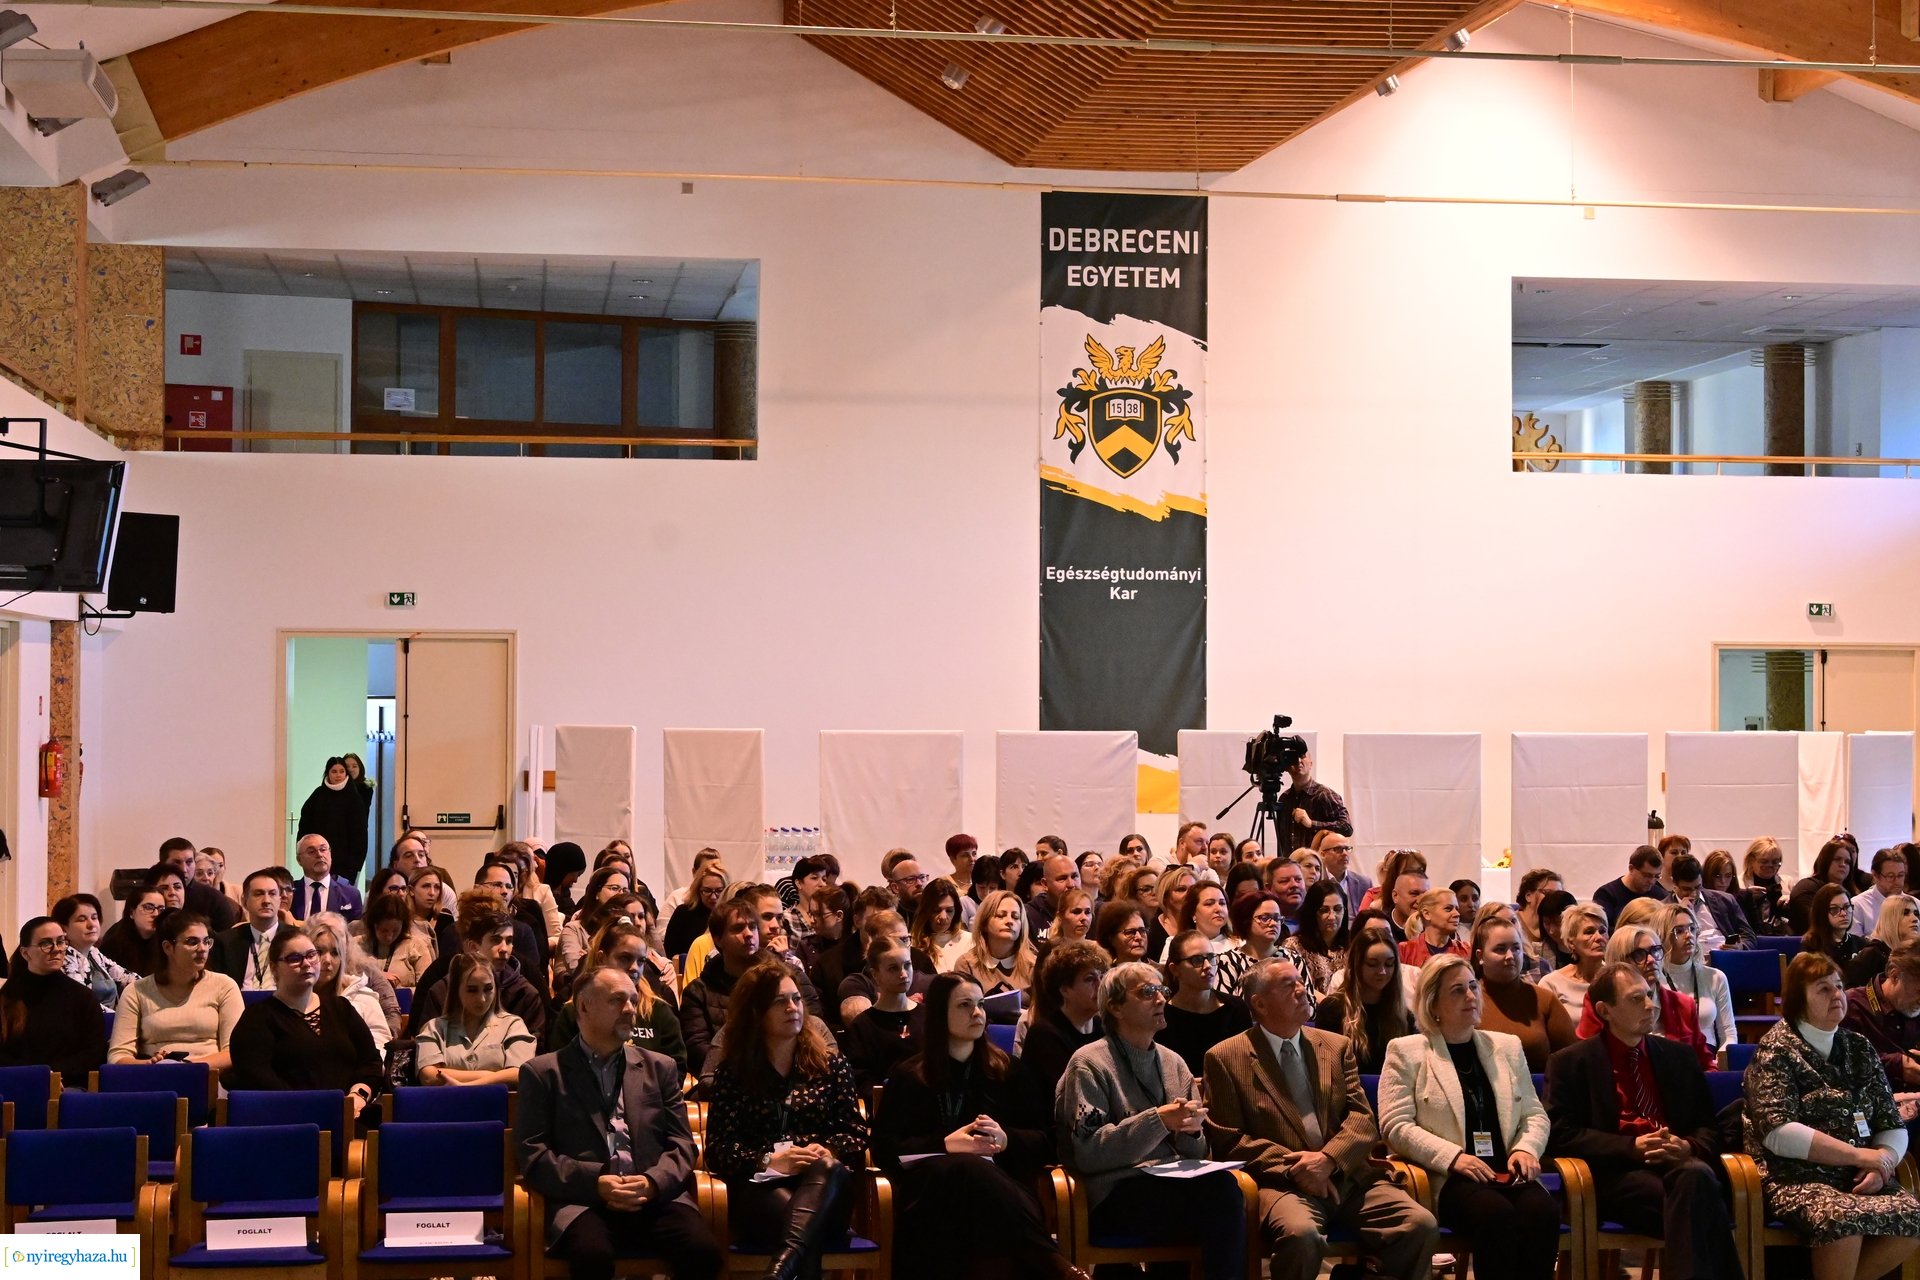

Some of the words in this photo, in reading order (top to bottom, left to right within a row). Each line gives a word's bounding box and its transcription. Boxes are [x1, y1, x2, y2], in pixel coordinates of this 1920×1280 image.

[1049, 227, 1199, 255] DEBRECENI
[1067, 265, 1181, 289] EGYETEM
[1111, 403, 1122, 414] 15
[1127, 403, 1139, 414] 38
[1046, 565, 1202, 584] Egészségtudományi
[1110, 586, 1139, 600] Kar
